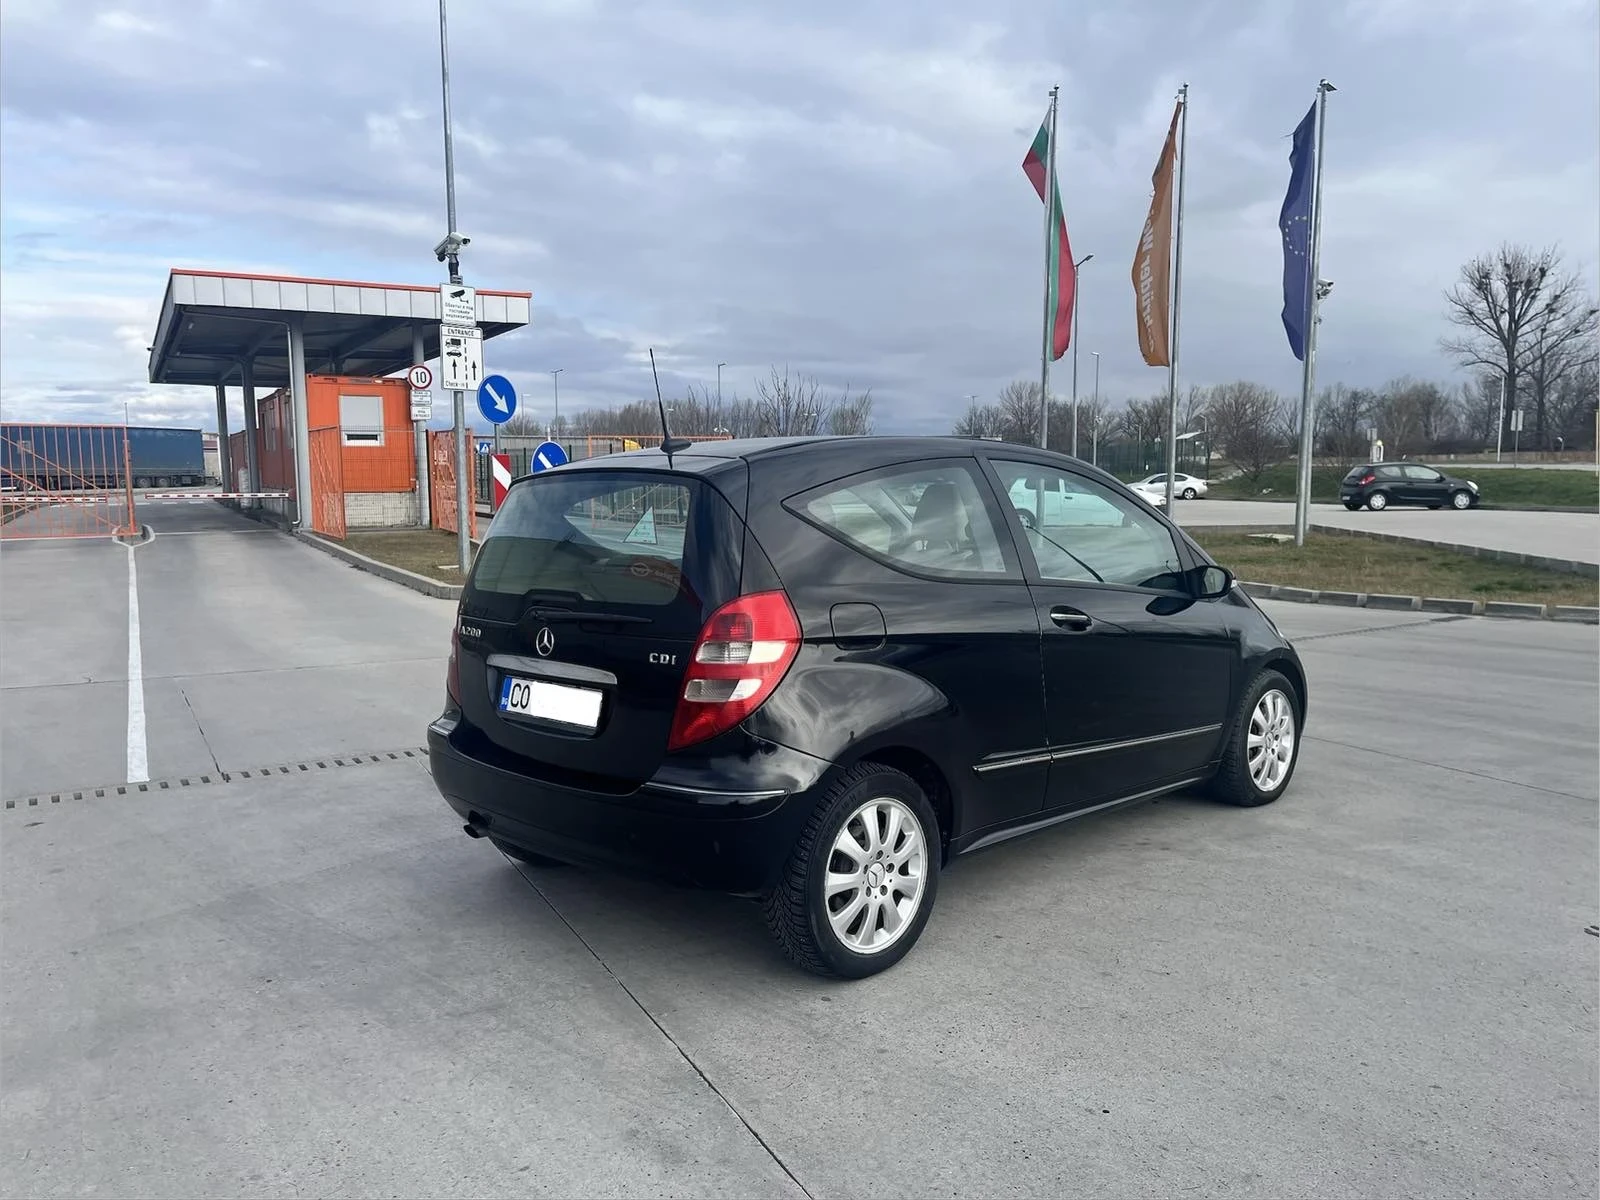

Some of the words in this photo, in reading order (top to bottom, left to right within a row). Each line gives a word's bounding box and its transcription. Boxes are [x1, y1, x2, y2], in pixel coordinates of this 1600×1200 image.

[447, 328, 475, 337] ENTRANCE
[415, 371, 427, 384] 10
[460, 625, 482, 638] A200
[649, 652, 677, 666] CDI
